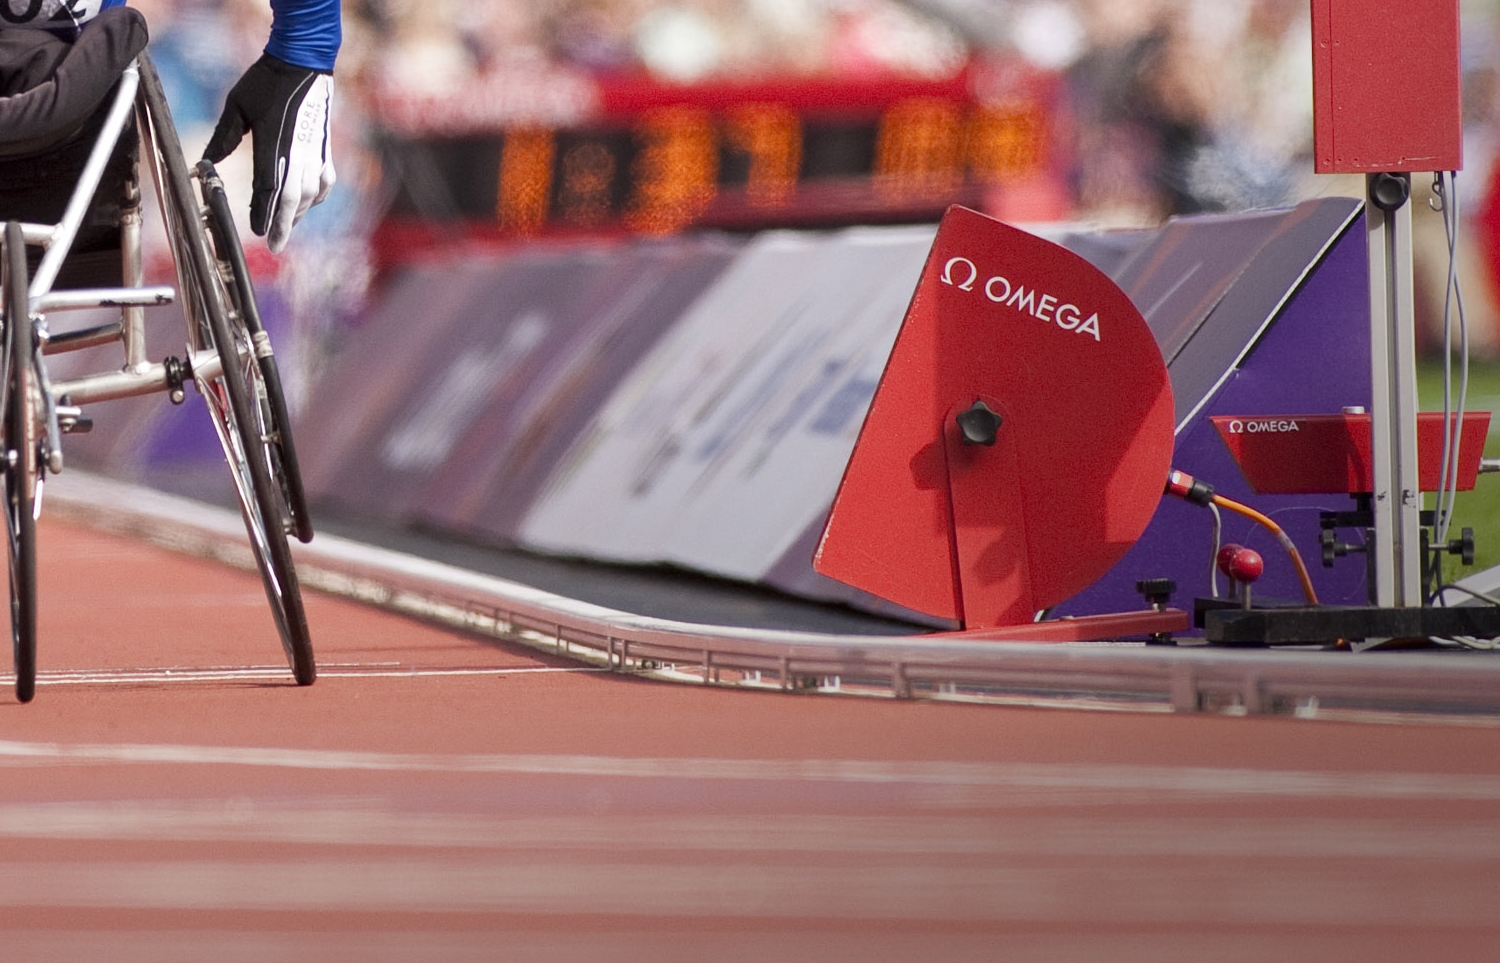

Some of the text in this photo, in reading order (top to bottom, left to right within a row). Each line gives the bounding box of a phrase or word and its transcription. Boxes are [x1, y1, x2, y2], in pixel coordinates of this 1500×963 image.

[297, 101, 315, 142] GORE
[985, 276, 1101, 341] OMEGA
[1247, 420, 1299, 433] OMEGA
